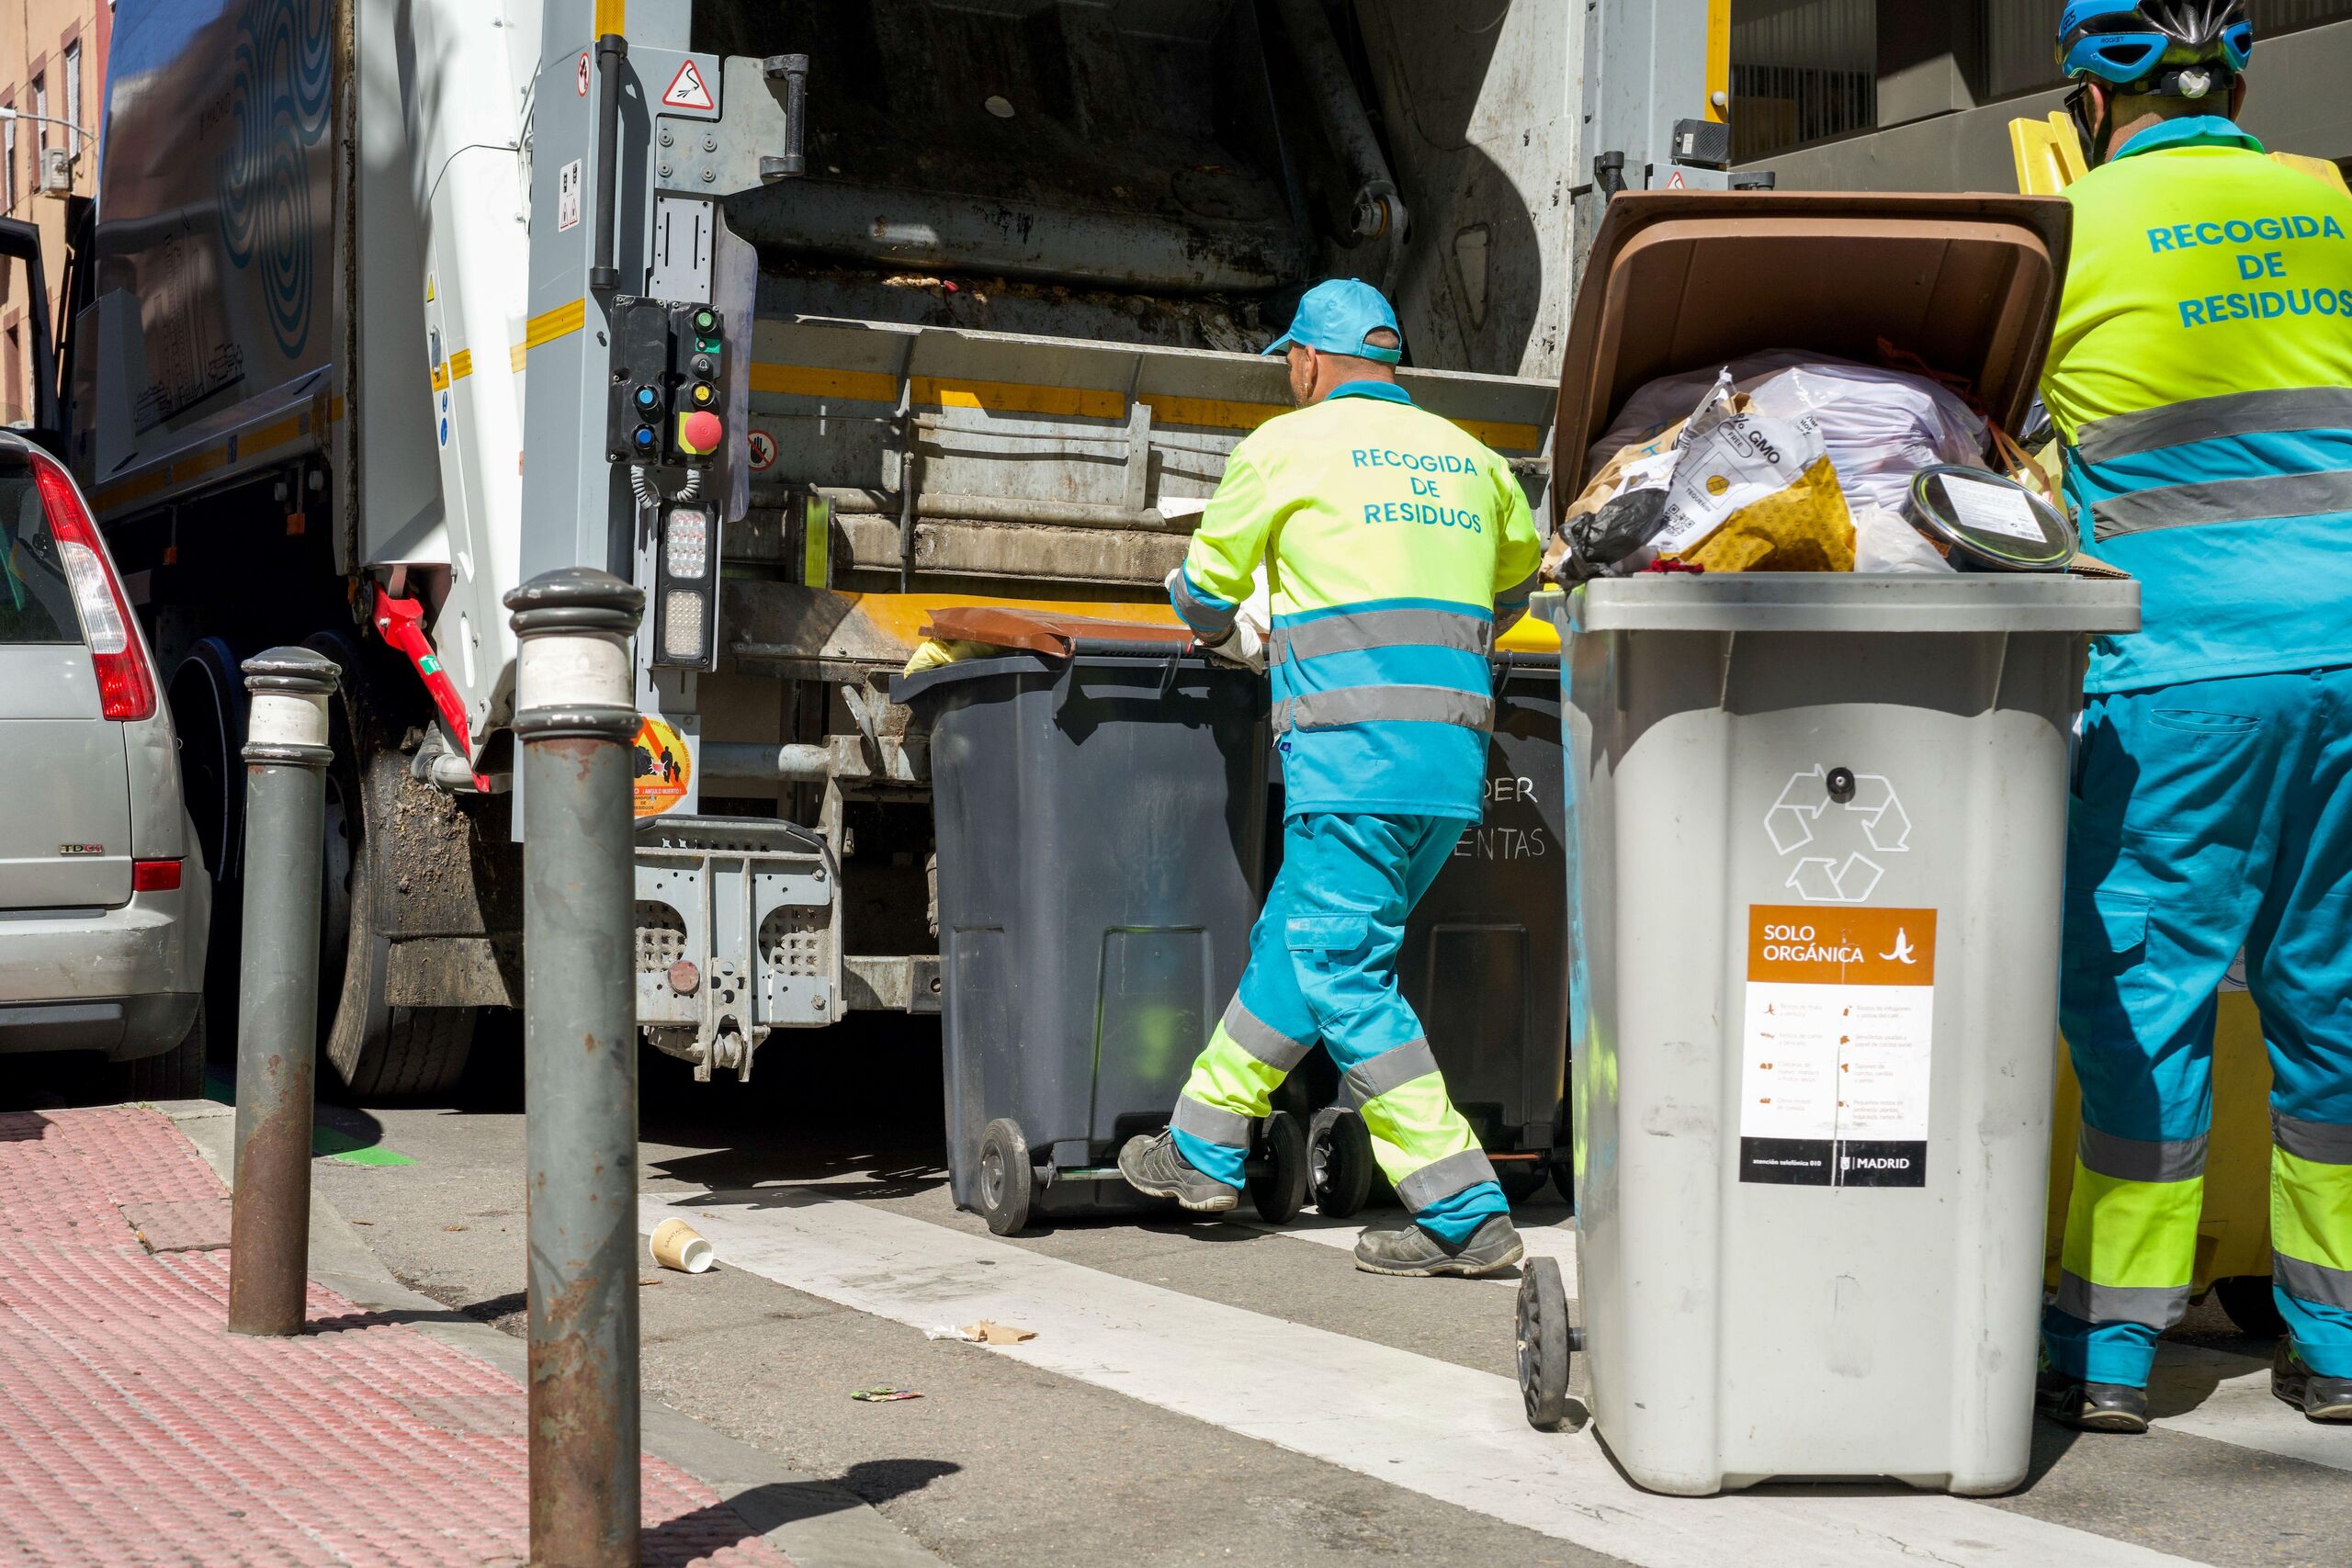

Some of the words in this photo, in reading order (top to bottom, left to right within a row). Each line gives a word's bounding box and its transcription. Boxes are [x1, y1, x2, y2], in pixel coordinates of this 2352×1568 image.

[2146, 215, 2346, 254] RECOGIDA
[2236, 251, 2287, 280] DE
[2178, 288, 2352, 328] RESIDUOS
[1727, 432, 1743, 448] FREE
[1748, 431, 1780, 464] GMO
[1352, 448, 1477, 476] RECOGIDA
[1410, 477, 1441, 498] DE
[1364, 502, 1481, 534] RESIDUOS
[1764, 924, 1815, 942] SOLO
[1763, 942, 1864, 964] ORGÁNICA
[1857, 1158, 1910, 1169] MADRID
